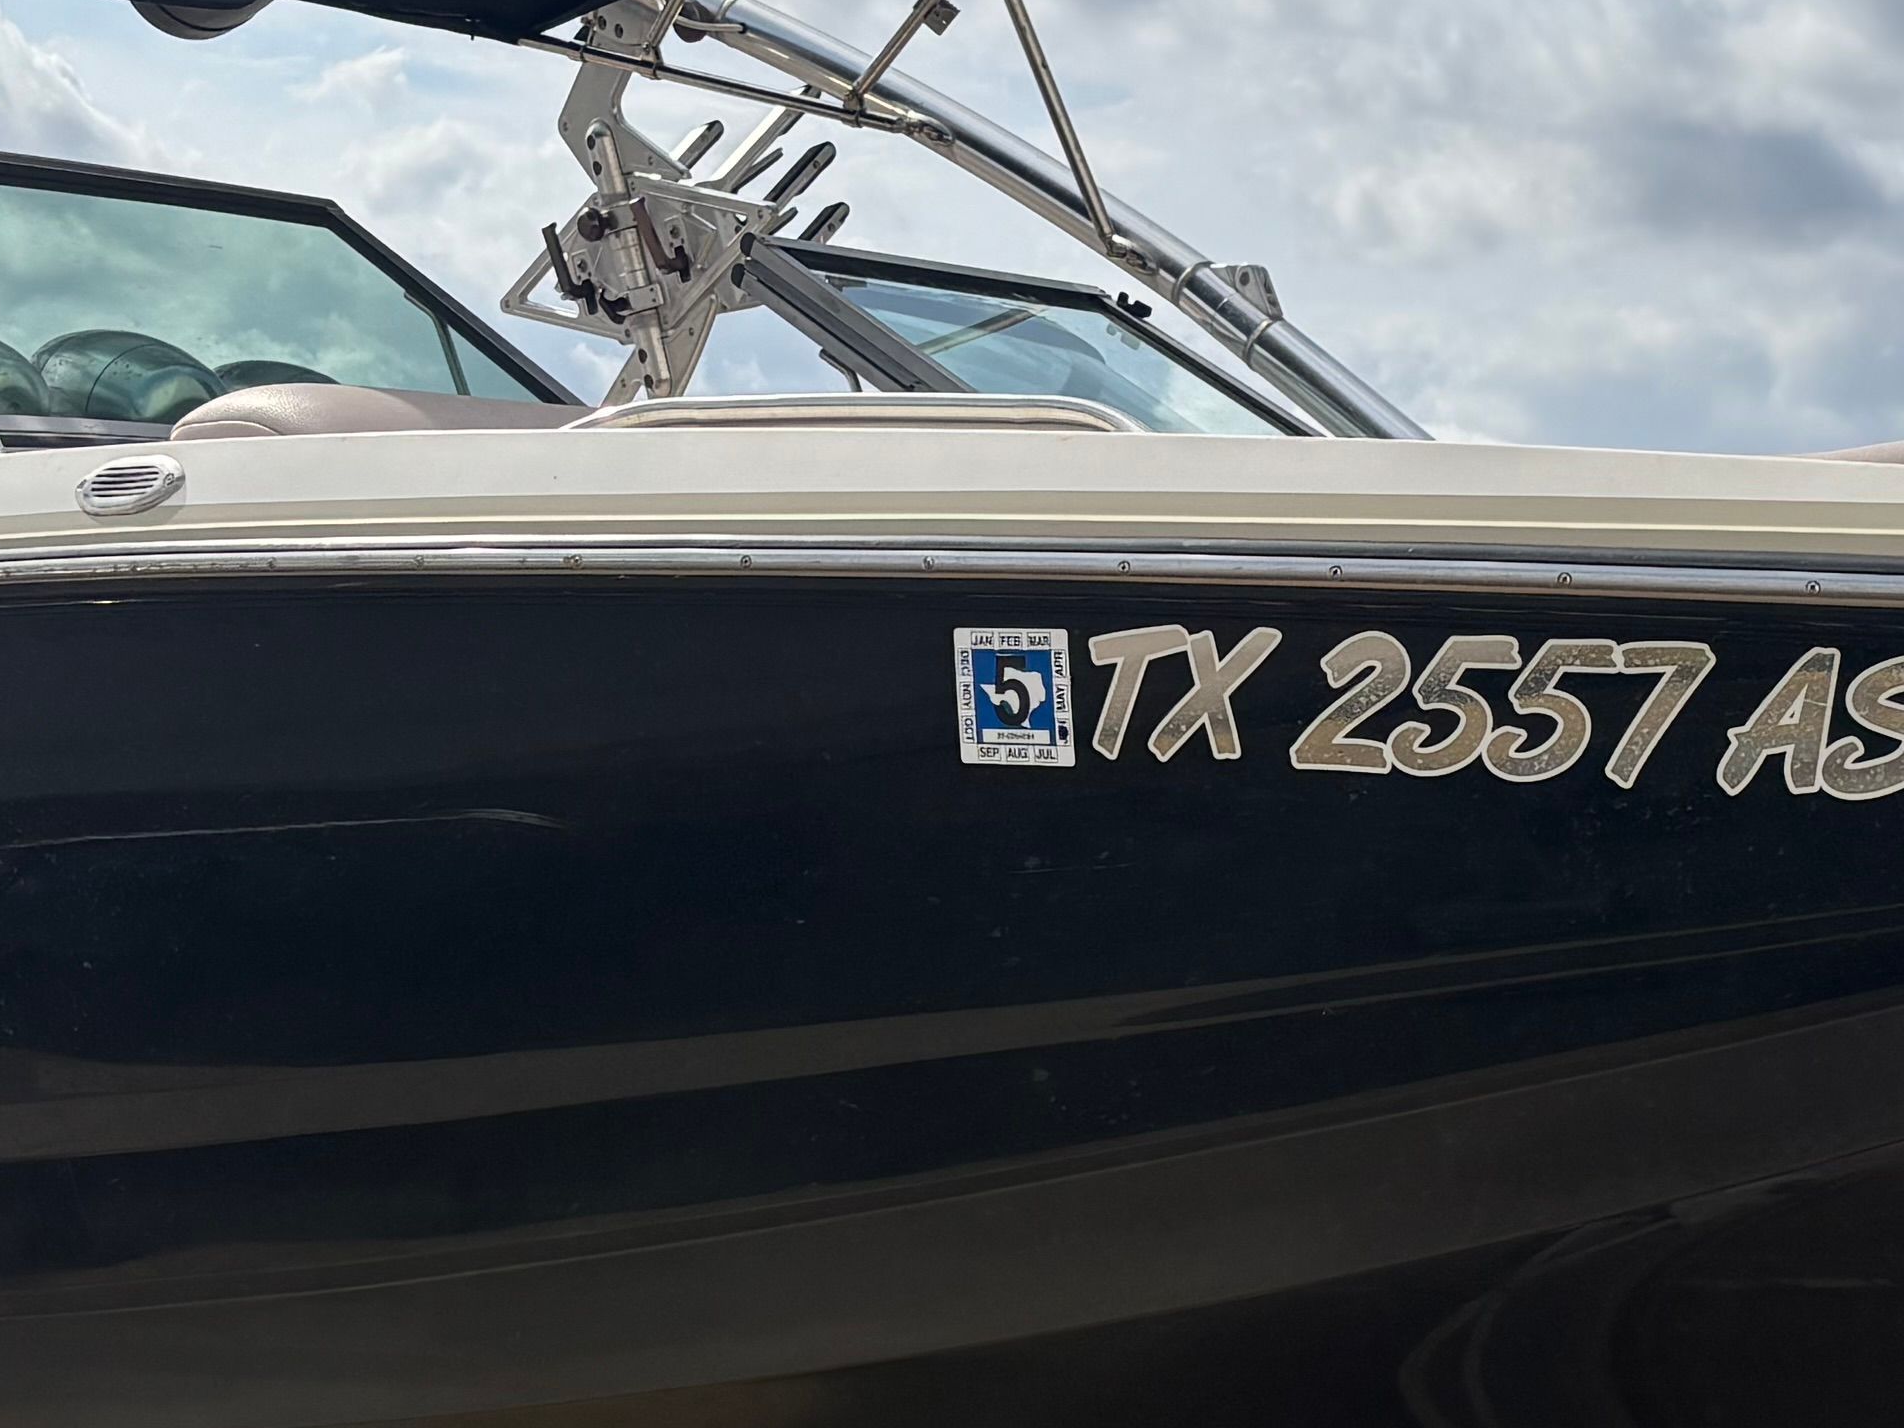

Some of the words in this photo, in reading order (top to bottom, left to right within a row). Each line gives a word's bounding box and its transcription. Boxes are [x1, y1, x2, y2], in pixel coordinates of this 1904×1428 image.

[995, 655, 1030, 727] 5
[1089, 626, 1282, 759] TX
[1289, 630, 1716, 789] 2557
[979, 747, 999, 758] SEP
[1007, 748, 1028, 759] AUG
[1036, 749, 1057, 760] JUL
